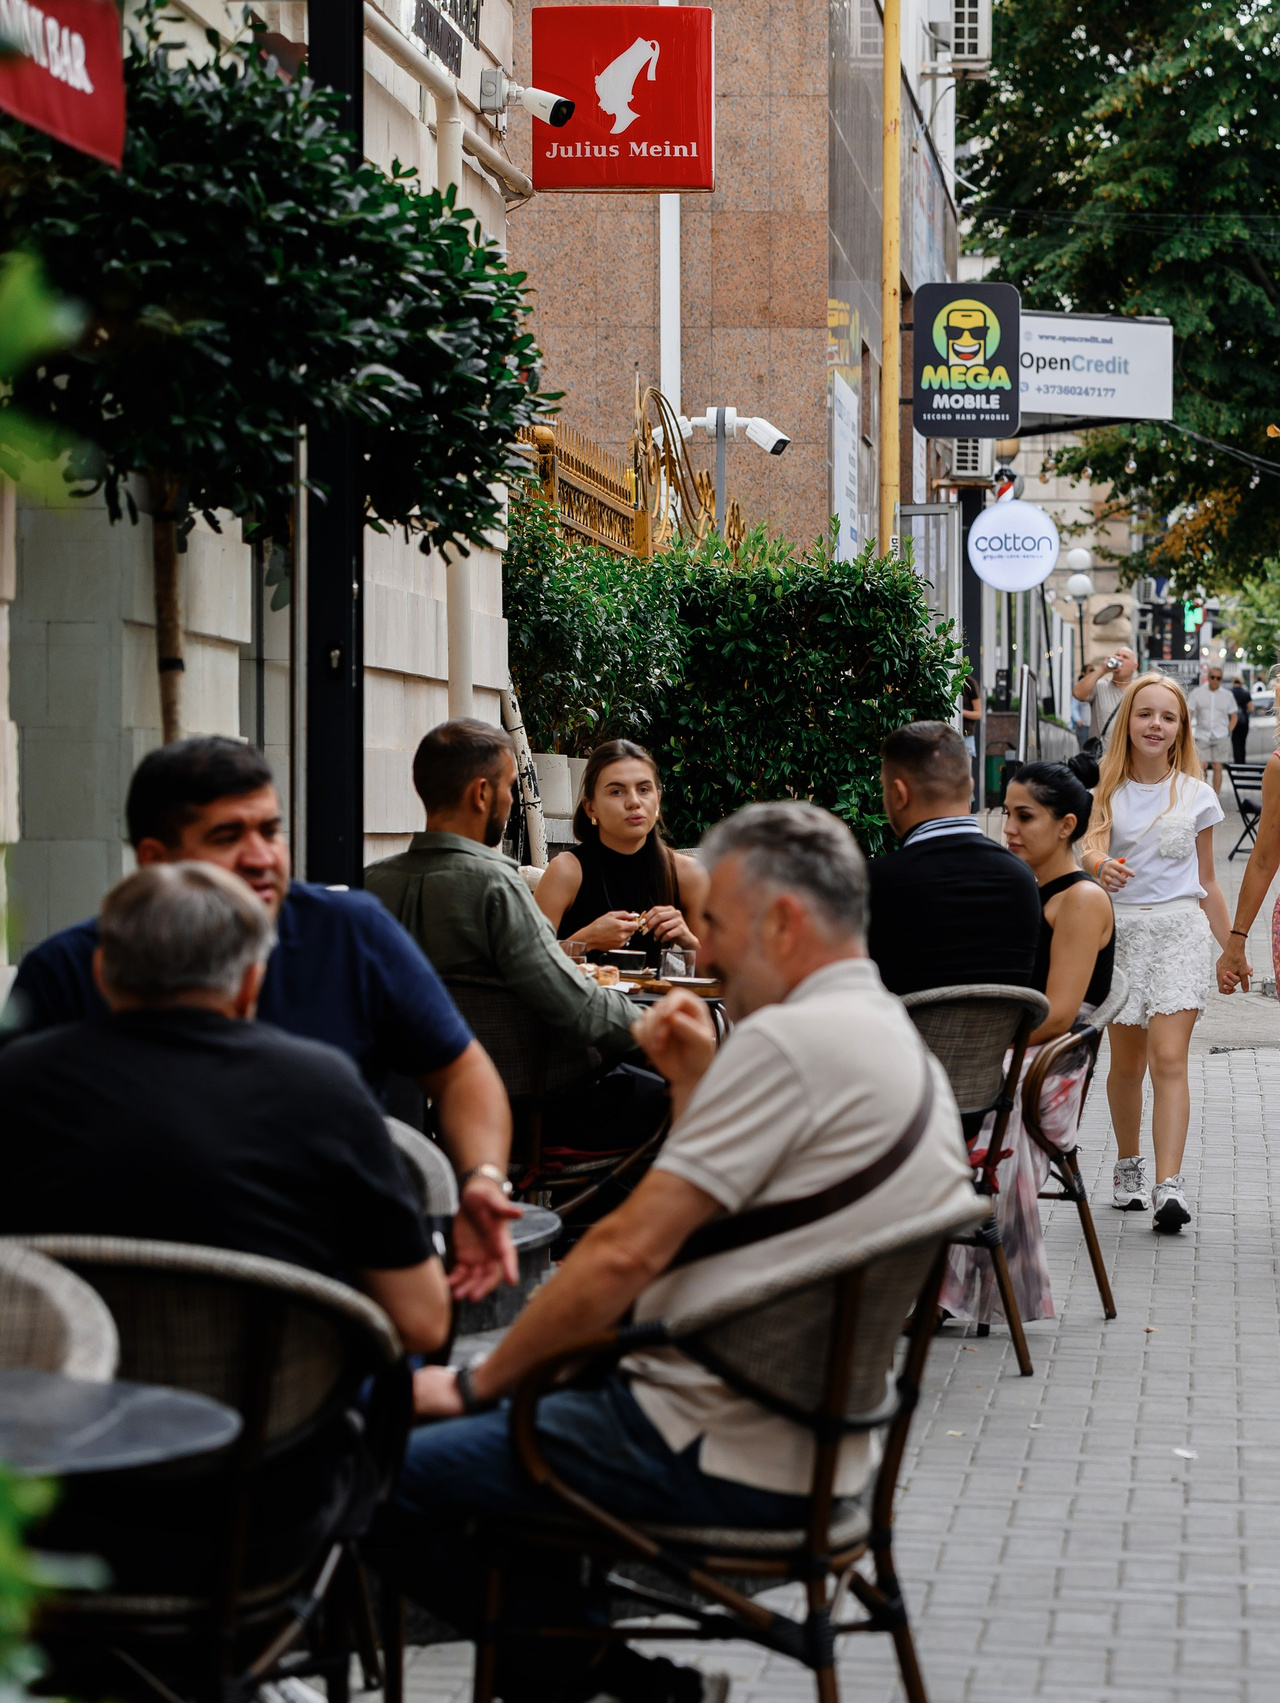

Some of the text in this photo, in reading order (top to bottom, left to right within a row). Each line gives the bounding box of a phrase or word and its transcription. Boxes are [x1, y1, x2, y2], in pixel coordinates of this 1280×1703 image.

[45, 16, 94, 94] BAR
[545, 140, 699, 159] Julius Meinl
[1020, 352, 1130, 375] OpenCredit
[920, 364, 1013, 391] MEGA
[1035, 384, 1116, 398] +37360247177
[932, 393, 1001, 410] MOBILE
[922, 413, 1010, 422] SECOND HAND PHONES
[975, 533, 1053, 552] cotton
